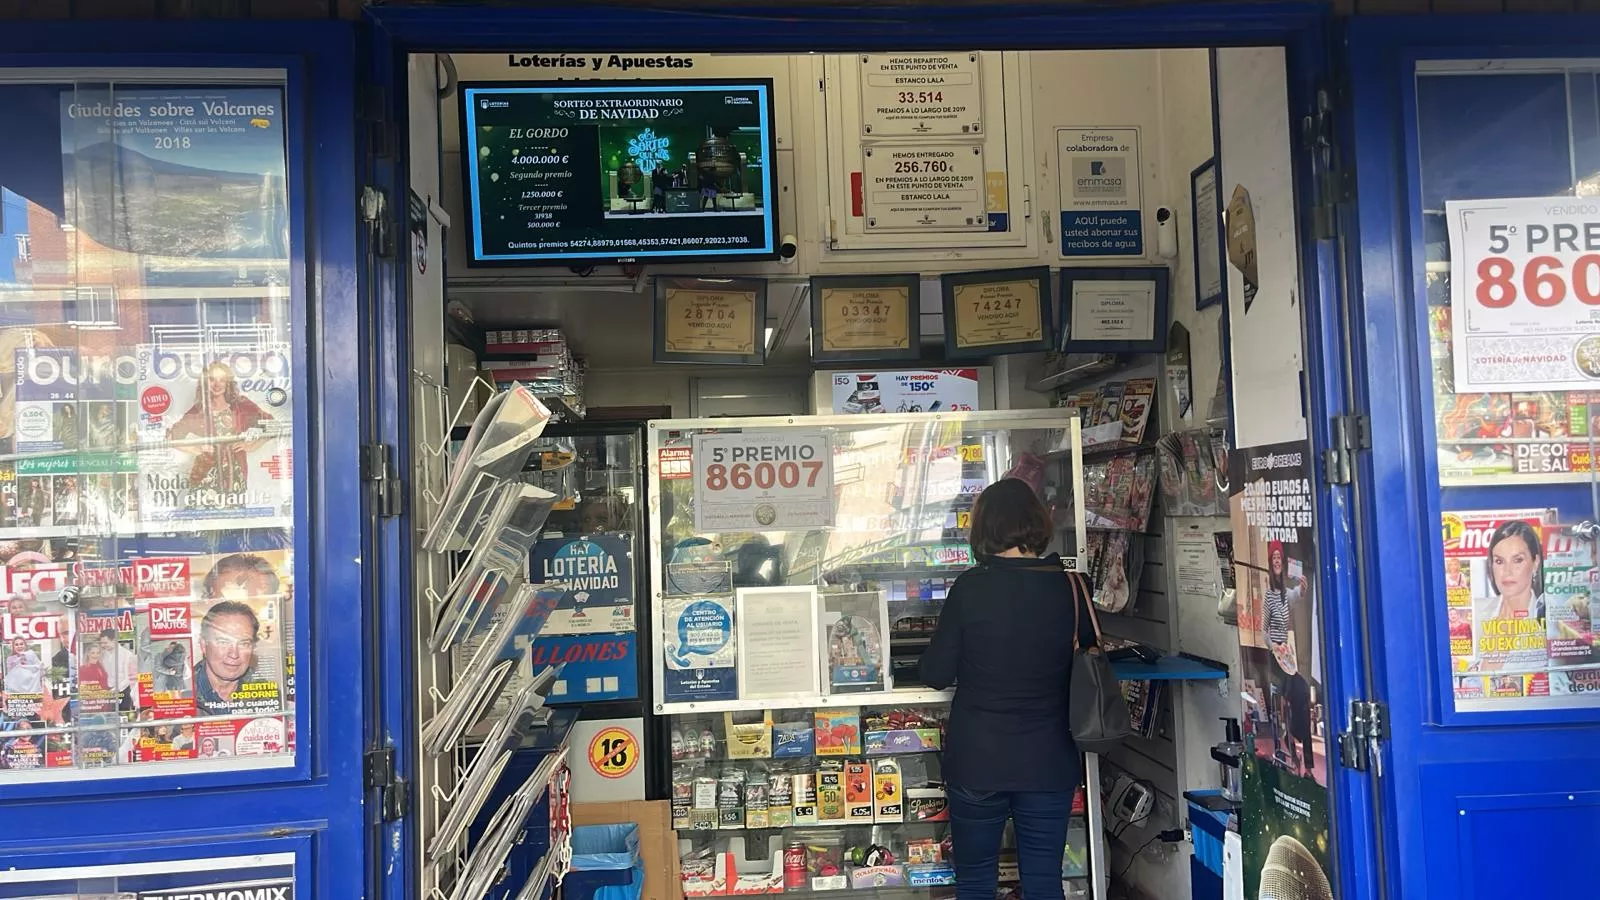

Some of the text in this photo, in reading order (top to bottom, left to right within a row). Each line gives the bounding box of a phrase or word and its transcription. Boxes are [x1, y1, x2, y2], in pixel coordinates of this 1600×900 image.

[508, 54, 693, 69] Loterías y Apuestas
[554, 98, 683, 108] SORTEO EXTRAORDINARIO
[898, 91, 943, 103] 33.514
[68, 102, 275, 117] Ciudades sobre Volcanes
[579, 108, 660, 120] DE NAVIDAD
[509, 128, 569, 139] EL GORDO
[1081, 134, 1114, 142] Empresa
[154, 137, 191, 149] 2018
[511, 155, 569, 165] 4.000.000 €
[895, 161, 947, 173] 256.760
[510, 171, 573, 180] Segundo premio
[542, 204, 567, 212] premio
[1075, 216, 1128, 226] AQUÍ puede
[1065, 228, 1089, 237] usted
[1091, 228, 1121, 237] abonar
[538, 241, 568, 249] premios
[1068, 239, 1136, 249] recibos de agua
[842, 305, 890, 316] 03347
[973, 298, 1021, 312] 74247
[684, 308, 736, 320] 28704
[909, 381, 935, 392] 150€
[661, 449, 690, 457] Alarma
[732, 444, 815, 462] PREMIO
[38, 459, 68, 471] mejores
[1518, 458, 1539, 473] EL
[706, 461, 824, 491] 86007
[147, 474, 189, 491] Moda
[1244, 478, 1301, 496] 20.000 EUROS
[153, 490, 271, 508] DIY elegante
[1241, 497, 1277, 512] MES PARA
[1246, 510, 1296, 528] TU SUEÑO DE
[1260, 526, 1298, 543] PINTORA
[570, 544, 590, 555] HAY
[543, 550, 618, 578] LOTERÍA
[138, 563, 185, 583] DIEZ
[138, 581, 185, 592] MINUTOS
[1545, 584, 1588, 595] Cocina
[152, 607, 187, 623] DIEZ
[80, 610, 134, 634] SEMANA
[152, 621, 188, 630] MINUTOS
[1482, 618, 1539, 635] VÍCTIMA
[1480, 638, 1496, 652] SU
[242, 682, 278, 692] BERTÍN
[1568, 681, 1585, 692] de
[231, 690, 279, 699] OSBORNE
[243, 733, 264, 741] cuida
[601, 738, 628, 768] 18
[911, 799, 945, 813] Smoking
[913, 876, 944, 884] mentos
